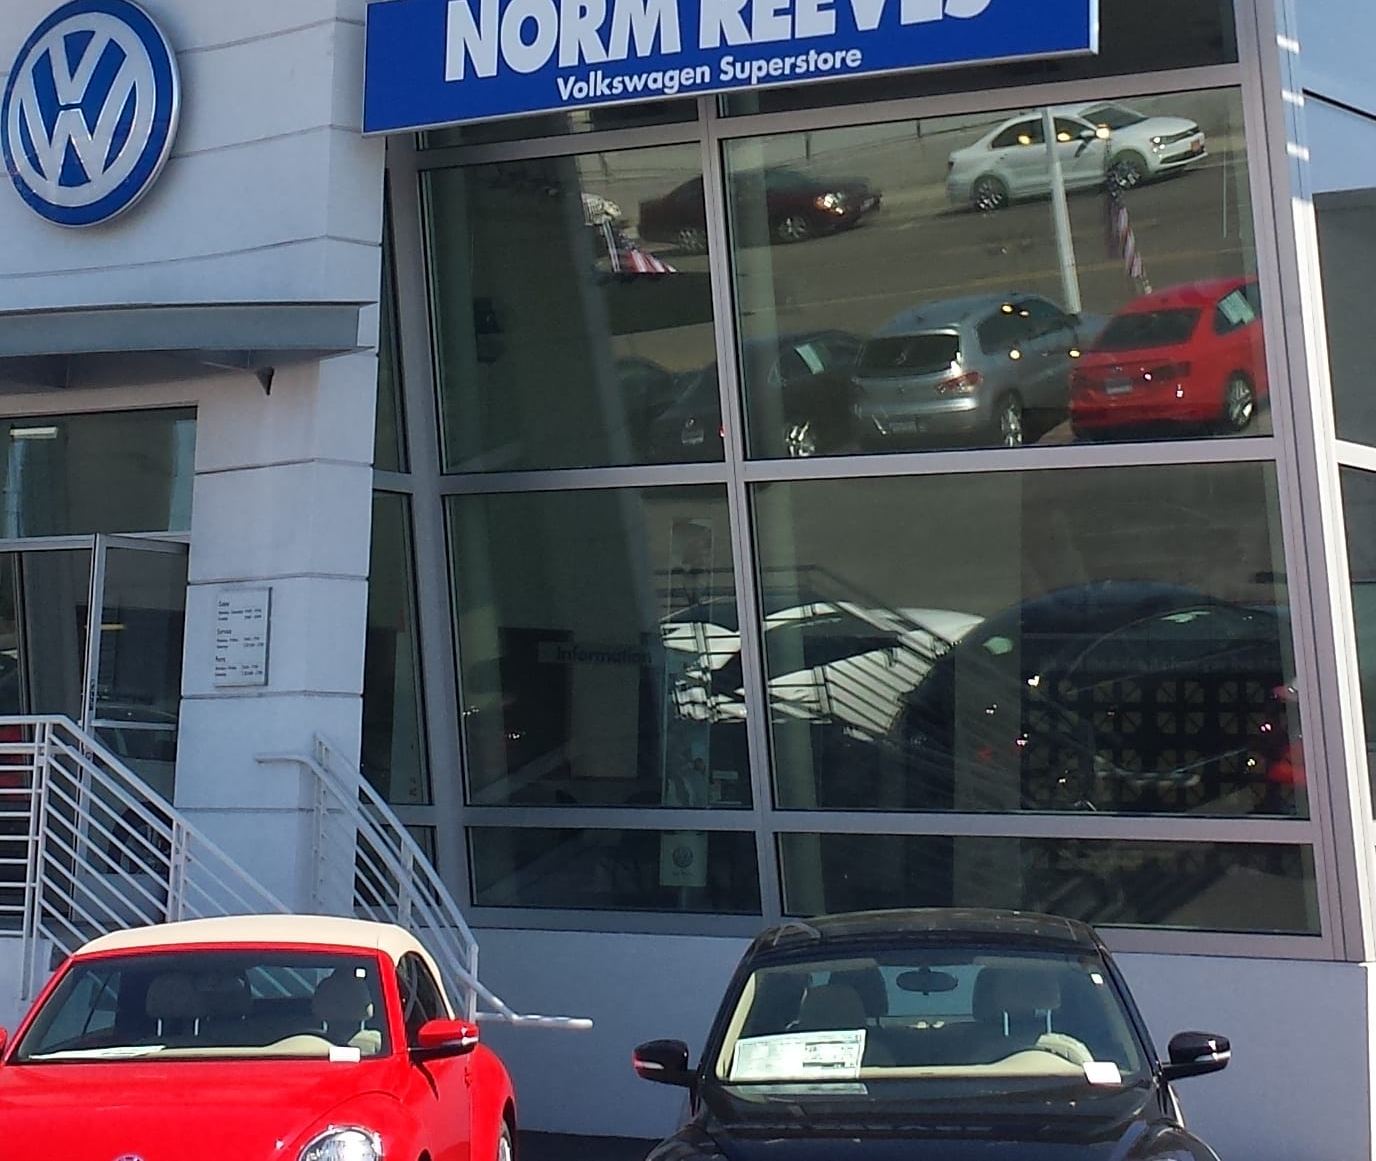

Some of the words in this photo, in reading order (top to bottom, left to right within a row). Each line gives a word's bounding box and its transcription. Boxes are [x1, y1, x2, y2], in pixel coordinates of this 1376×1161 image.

[557, 64, 711, 101] Volkswagen
[719, 48, 863, 84] Superstore
[8, 11, 157, 207] VW
[557, 643, 652, 664] Information
